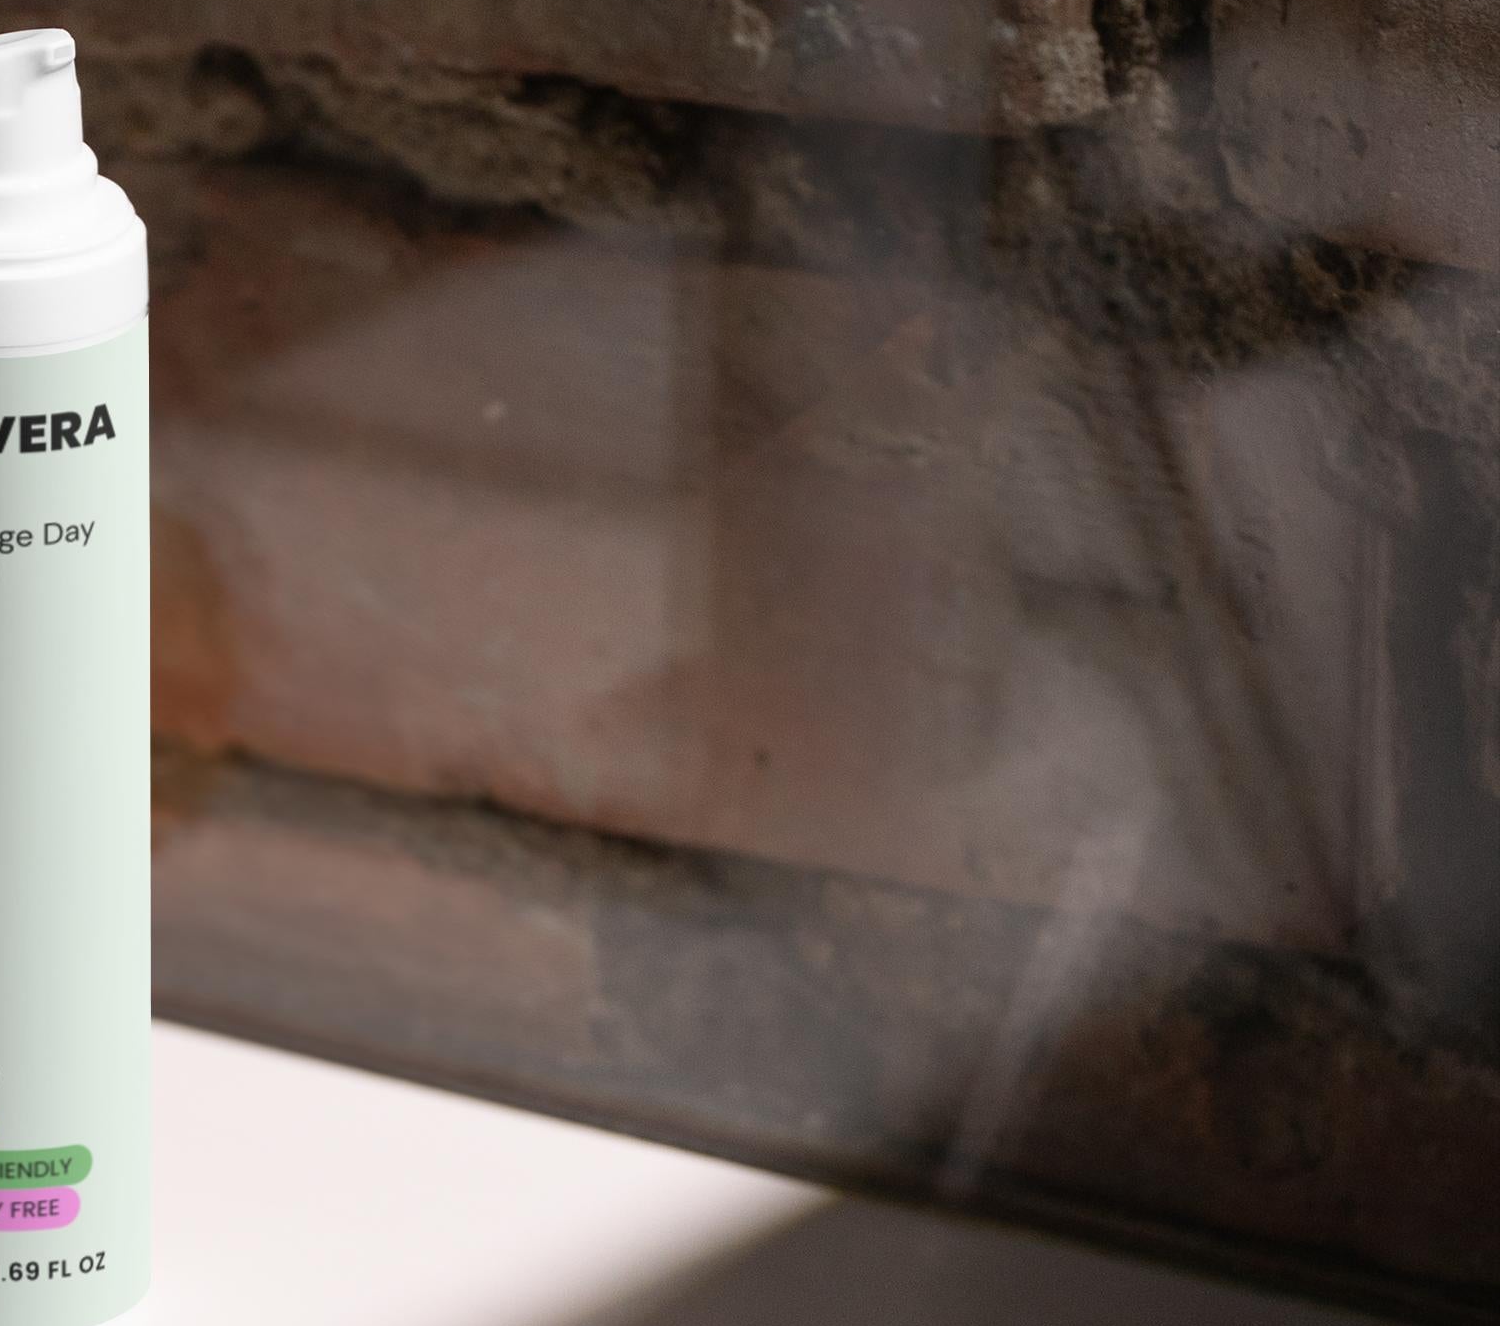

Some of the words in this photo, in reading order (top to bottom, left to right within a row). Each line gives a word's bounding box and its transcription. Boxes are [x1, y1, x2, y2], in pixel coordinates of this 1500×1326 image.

[44, 520, 96, 547] Day
[10, 1197, 60, 1219] FREE
[48, 1260, 72, 1280] FL
[79, 1251, 107, 1274] OZ
